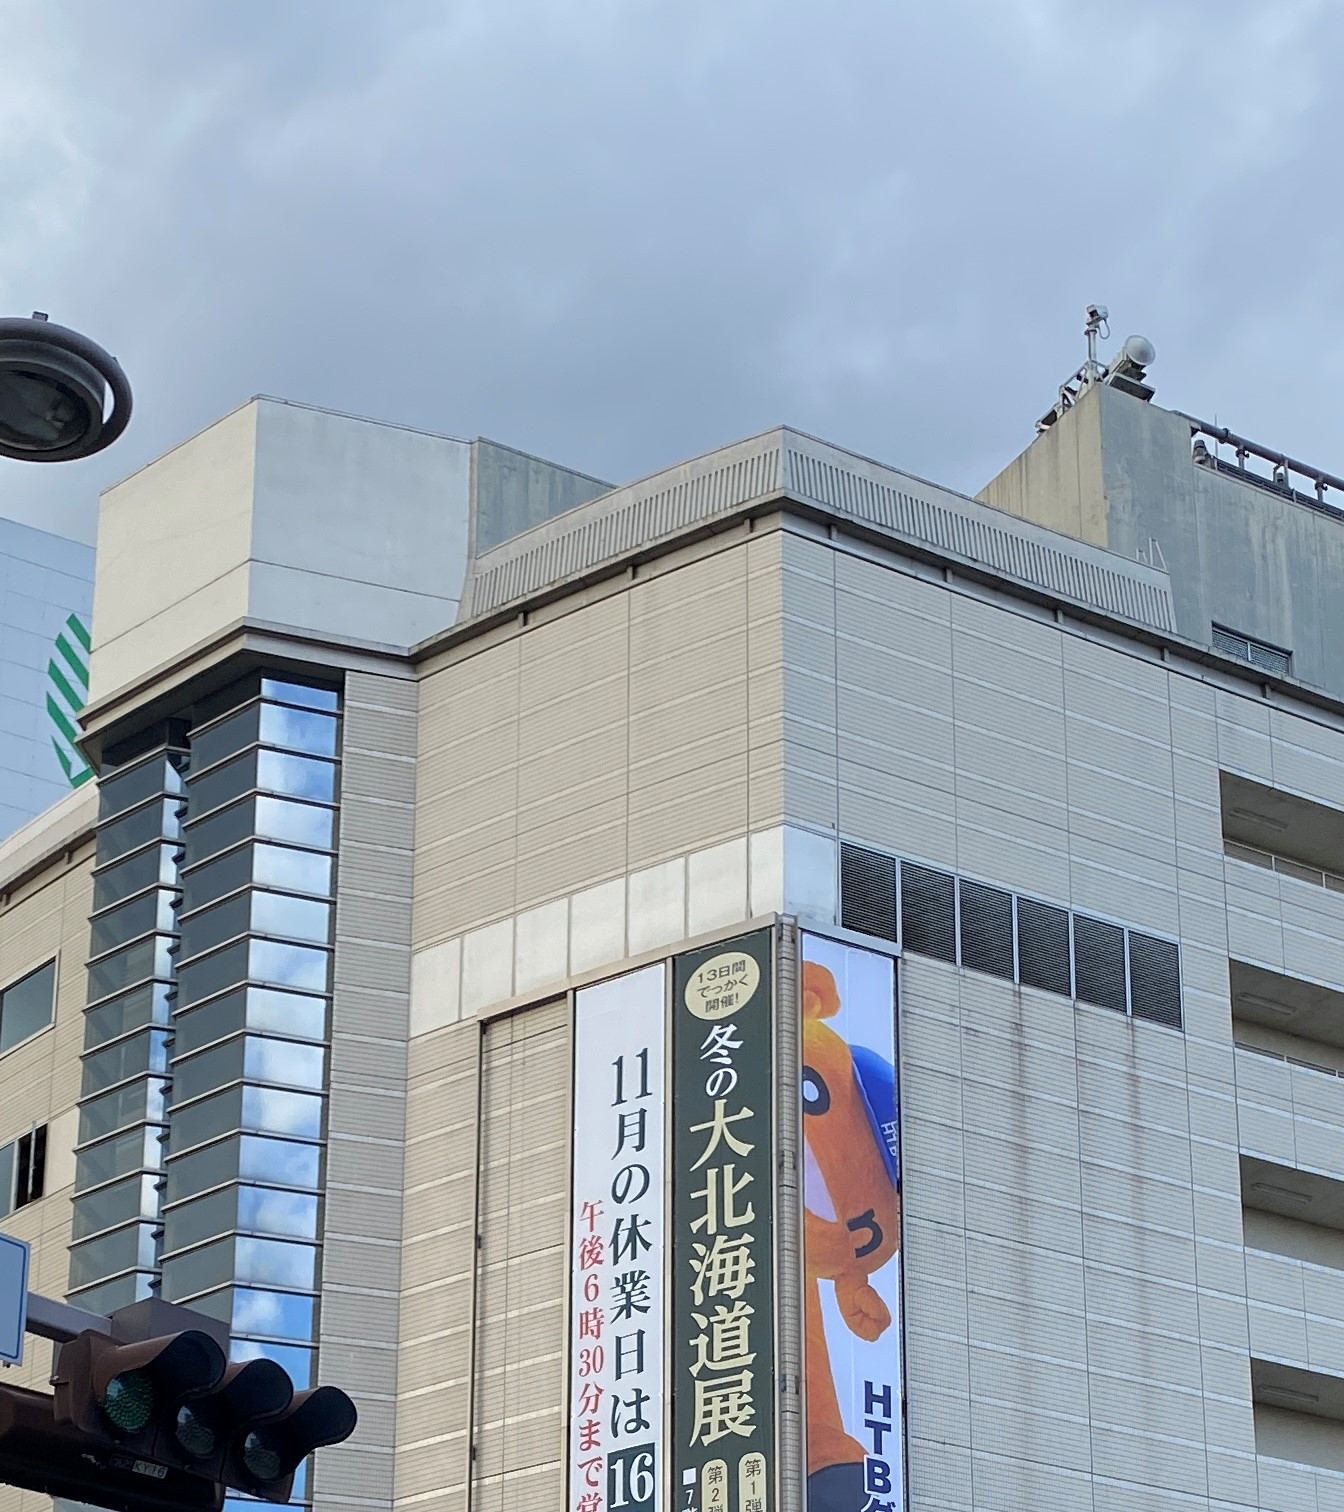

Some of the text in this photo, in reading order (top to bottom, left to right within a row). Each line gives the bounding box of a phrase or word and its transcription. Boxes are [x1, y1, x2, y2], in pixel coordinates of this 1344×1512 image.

[697, 960, 746, 984] 13日間
[697, 974, 749, 998] でっかく
[689, 1023, 757, 1447] 冬の大北海道展
